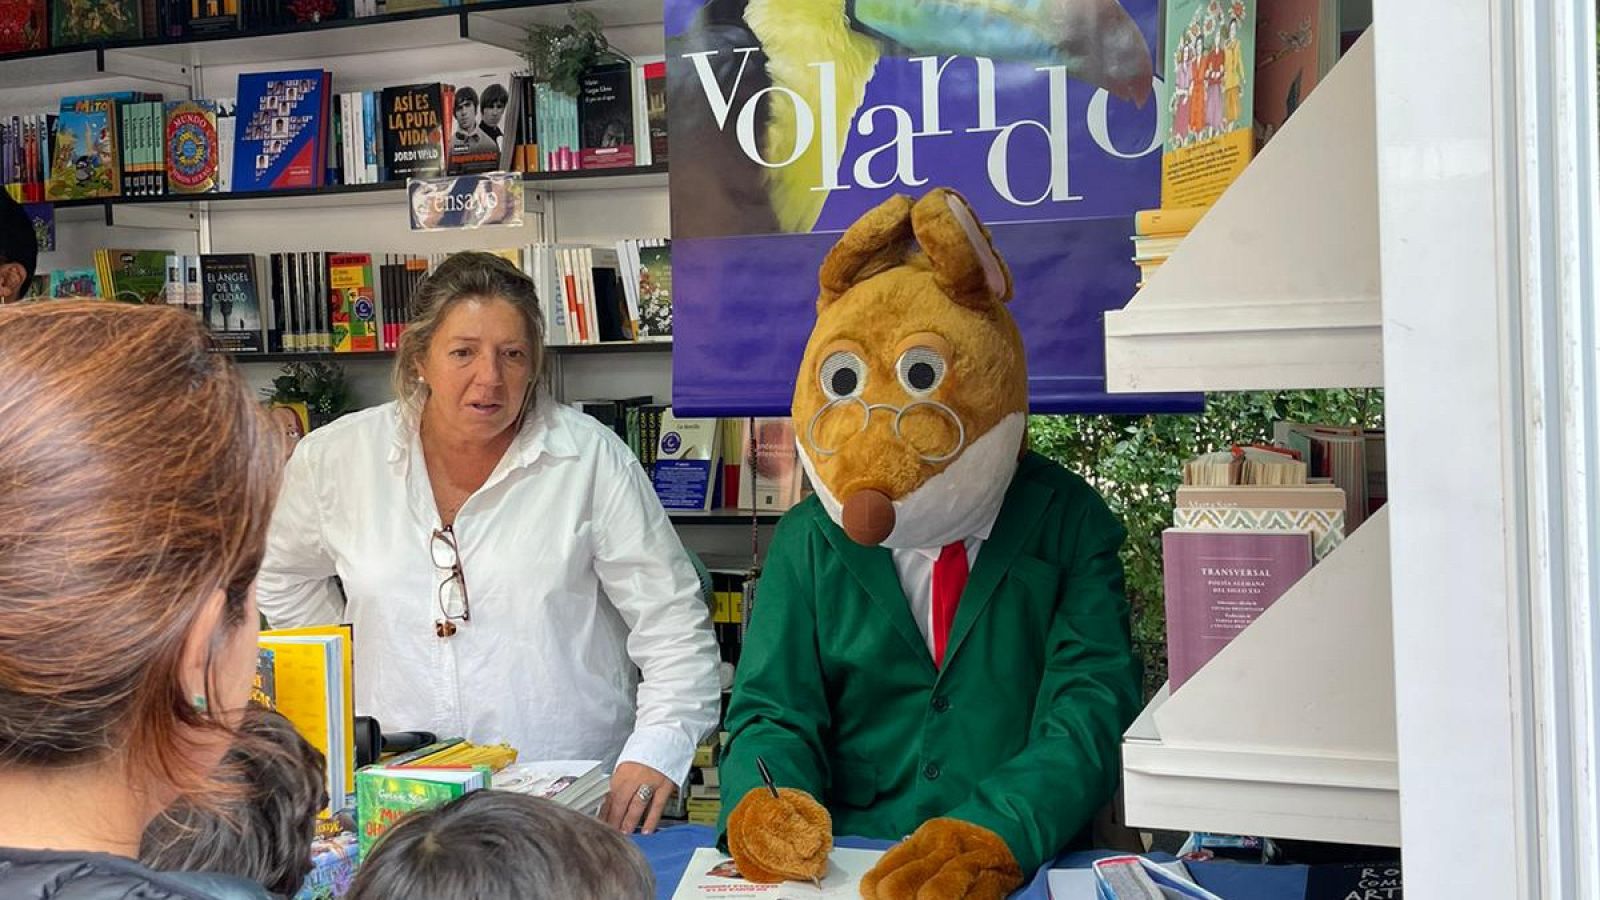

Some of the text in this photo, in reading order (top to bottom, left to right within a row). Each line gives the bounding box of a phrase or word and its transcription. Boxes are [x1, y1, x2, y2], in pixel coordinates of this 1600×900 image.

[394, 91, 429, 112] ASÍ ES
[173, 113, 207, 128] MUNDO
[389, 110, 437, 130] LA PUTA
[399, 128, 429, 146] VIDA
[394, 151, 417, 162] JORDI
[418, 149, 438, 160] WILD
[434, 192, 498, 218] ensayo
[207, 272, 216, 282] EL
[215, 282, 242, 292] DE LA
[212, 292, 247, 303] CIUDAD
[1200, 567, 1271, 577] TRANSVERSAL
